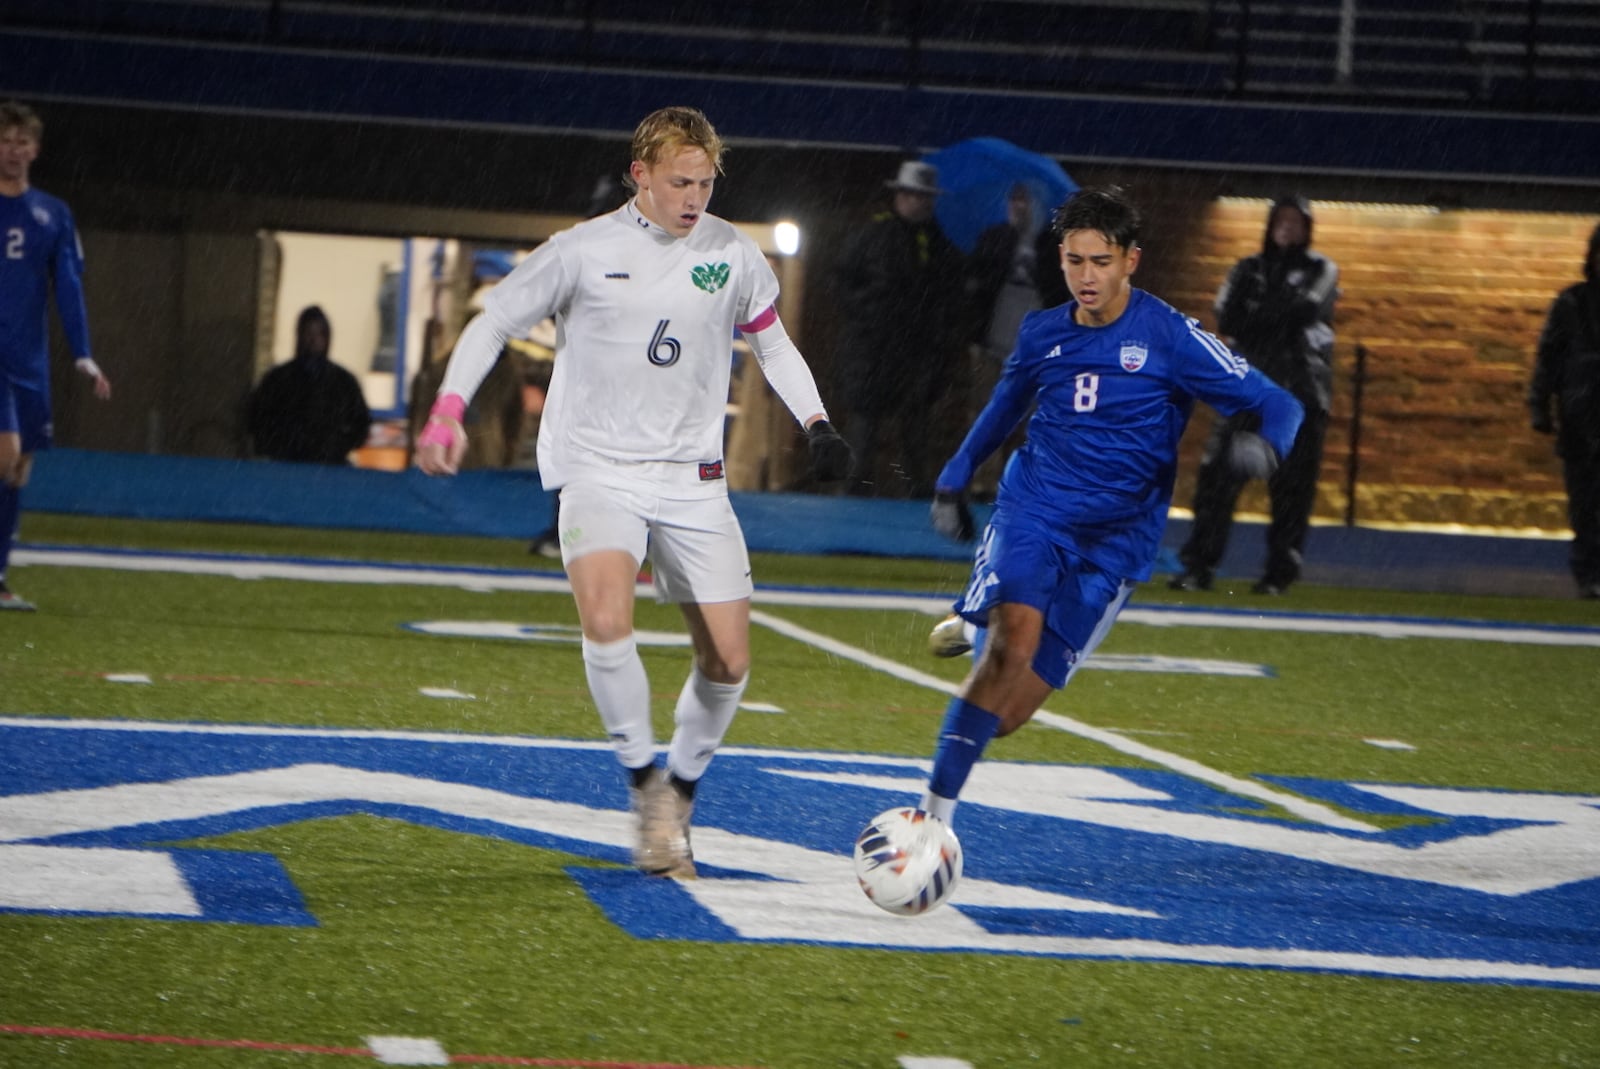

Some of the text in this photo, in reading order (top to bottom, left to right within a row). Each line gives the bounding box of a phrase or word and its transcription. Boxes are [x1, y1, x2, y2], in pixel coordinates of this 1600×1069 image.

[6, 227, 25, 259] 2
[647, 319, 681, 368] 6
[1073, 372, 1099, 413] 8
